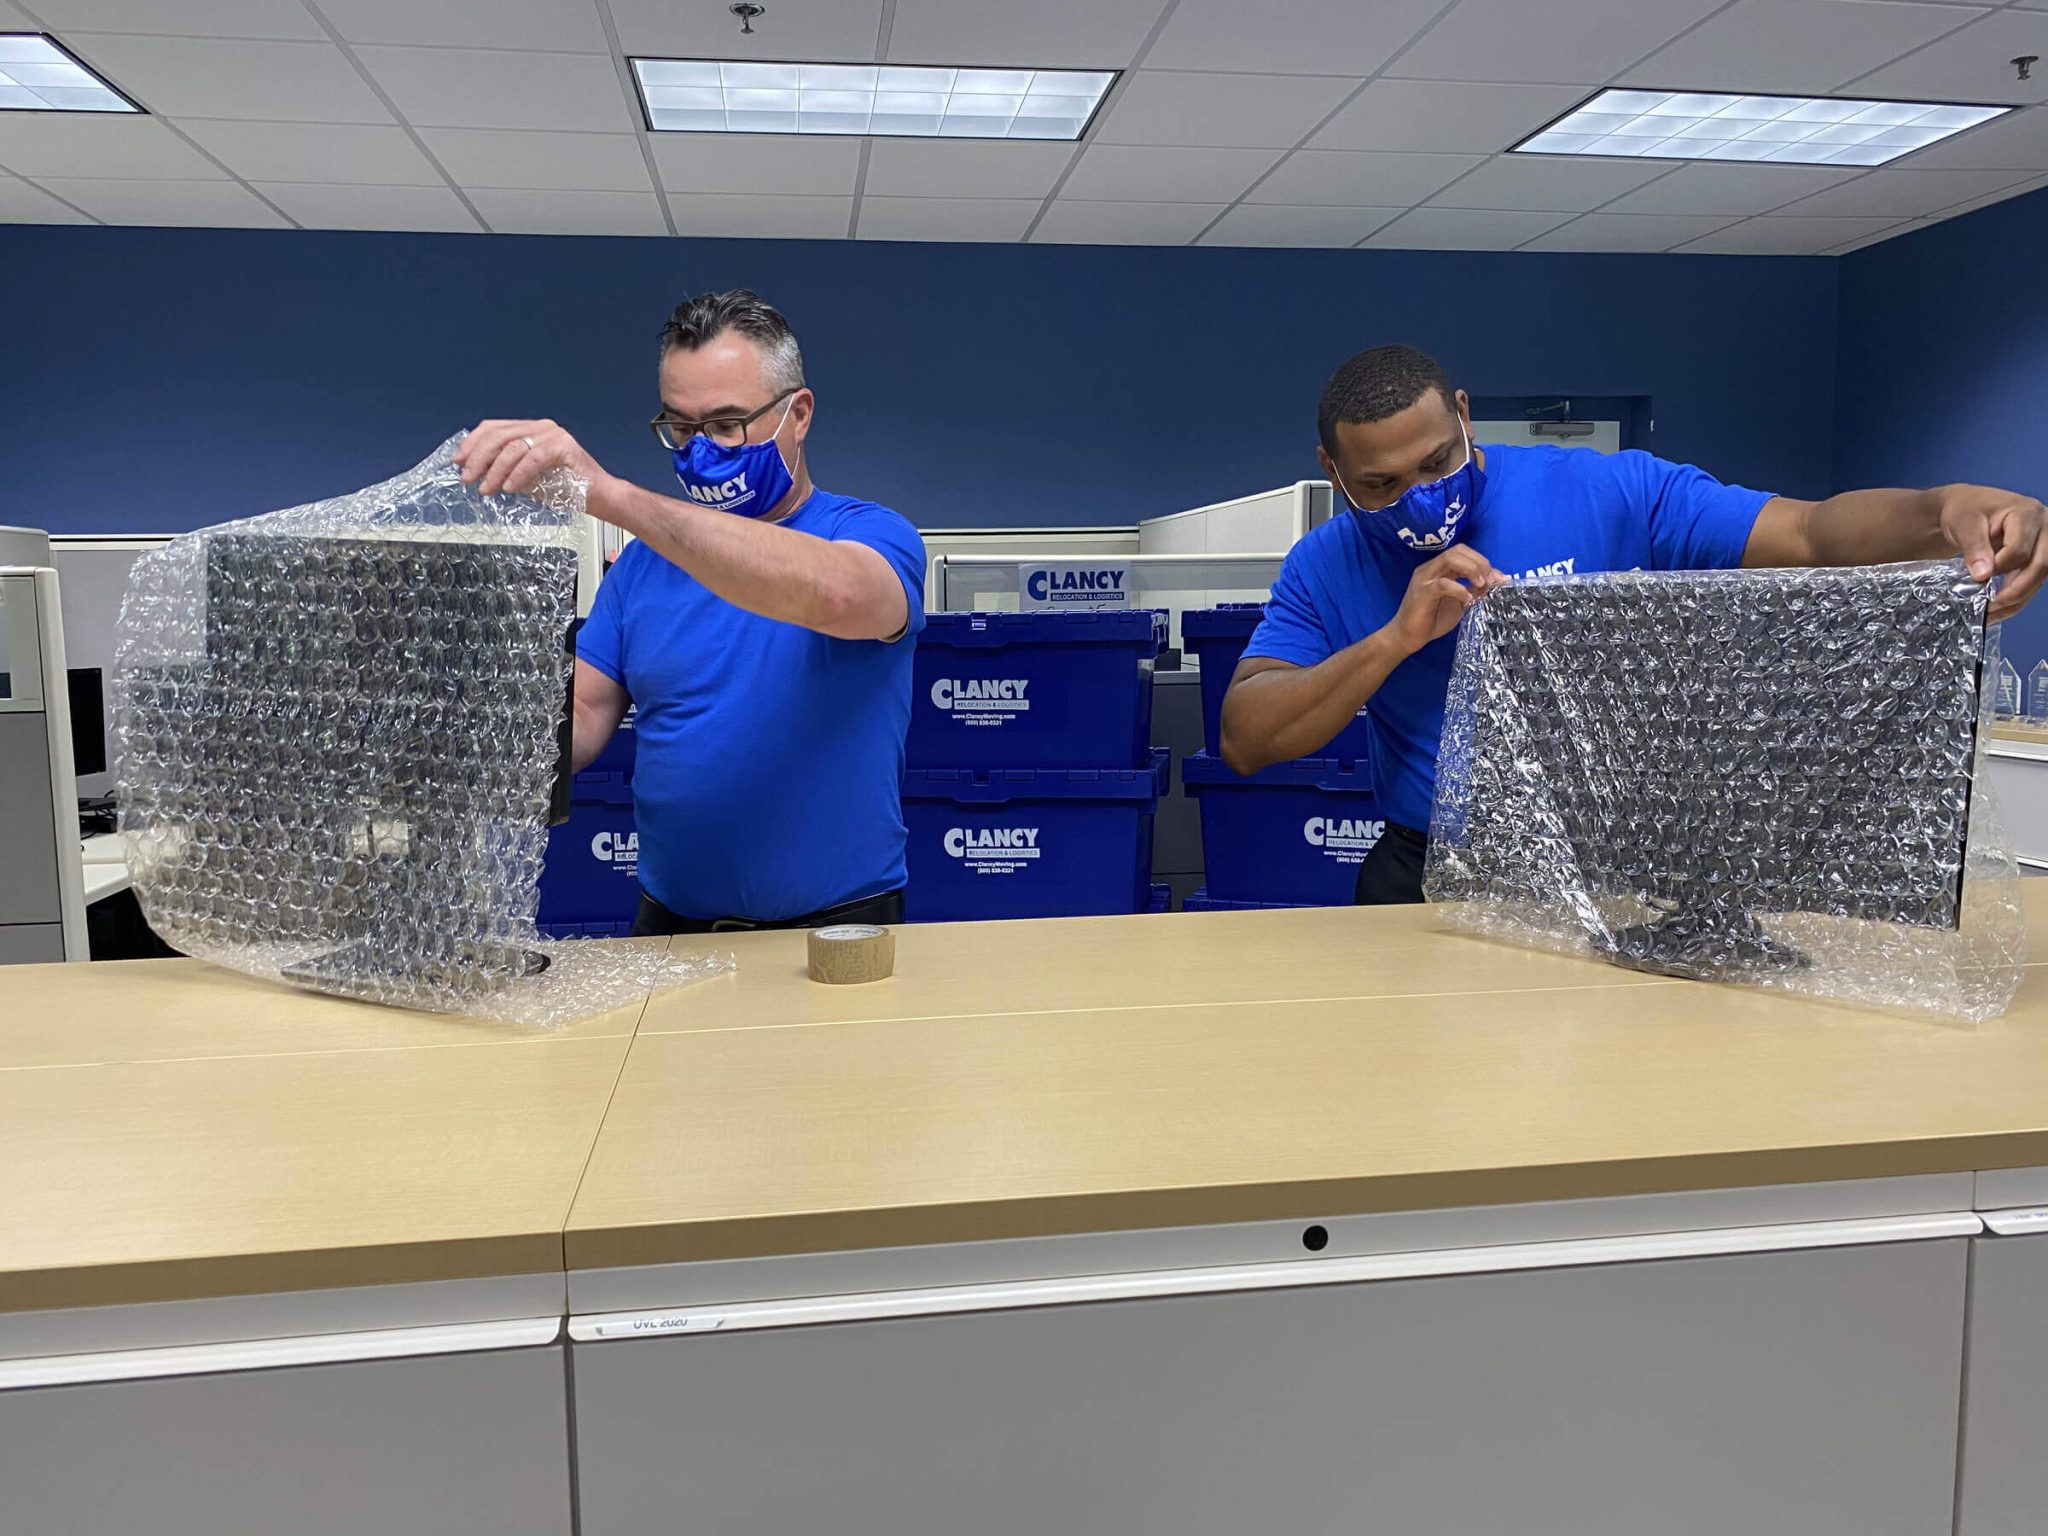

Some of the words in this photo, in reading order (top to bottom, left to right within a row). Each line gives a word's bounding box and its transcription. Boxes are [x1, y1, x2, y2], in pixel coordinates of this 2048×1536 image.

[676, 471, 748, 502] LANCY
[1027, 570, 1125, 601] CLANCY
[1093, 592, 1123, 600] LOGISTICS
[931, 679, 1029, 709] CLANCY
[591, 831, 640, 861] CLA
[944, 827, 1039, 858] CLANCY
[1303, 816, 1386, 846] CLANC
[1328, 839, 1364, 847] RELOCATION
[968, 849, 1003, 857] RELOCATION
[1009, 849, 1039, 857] LOGISTICS
